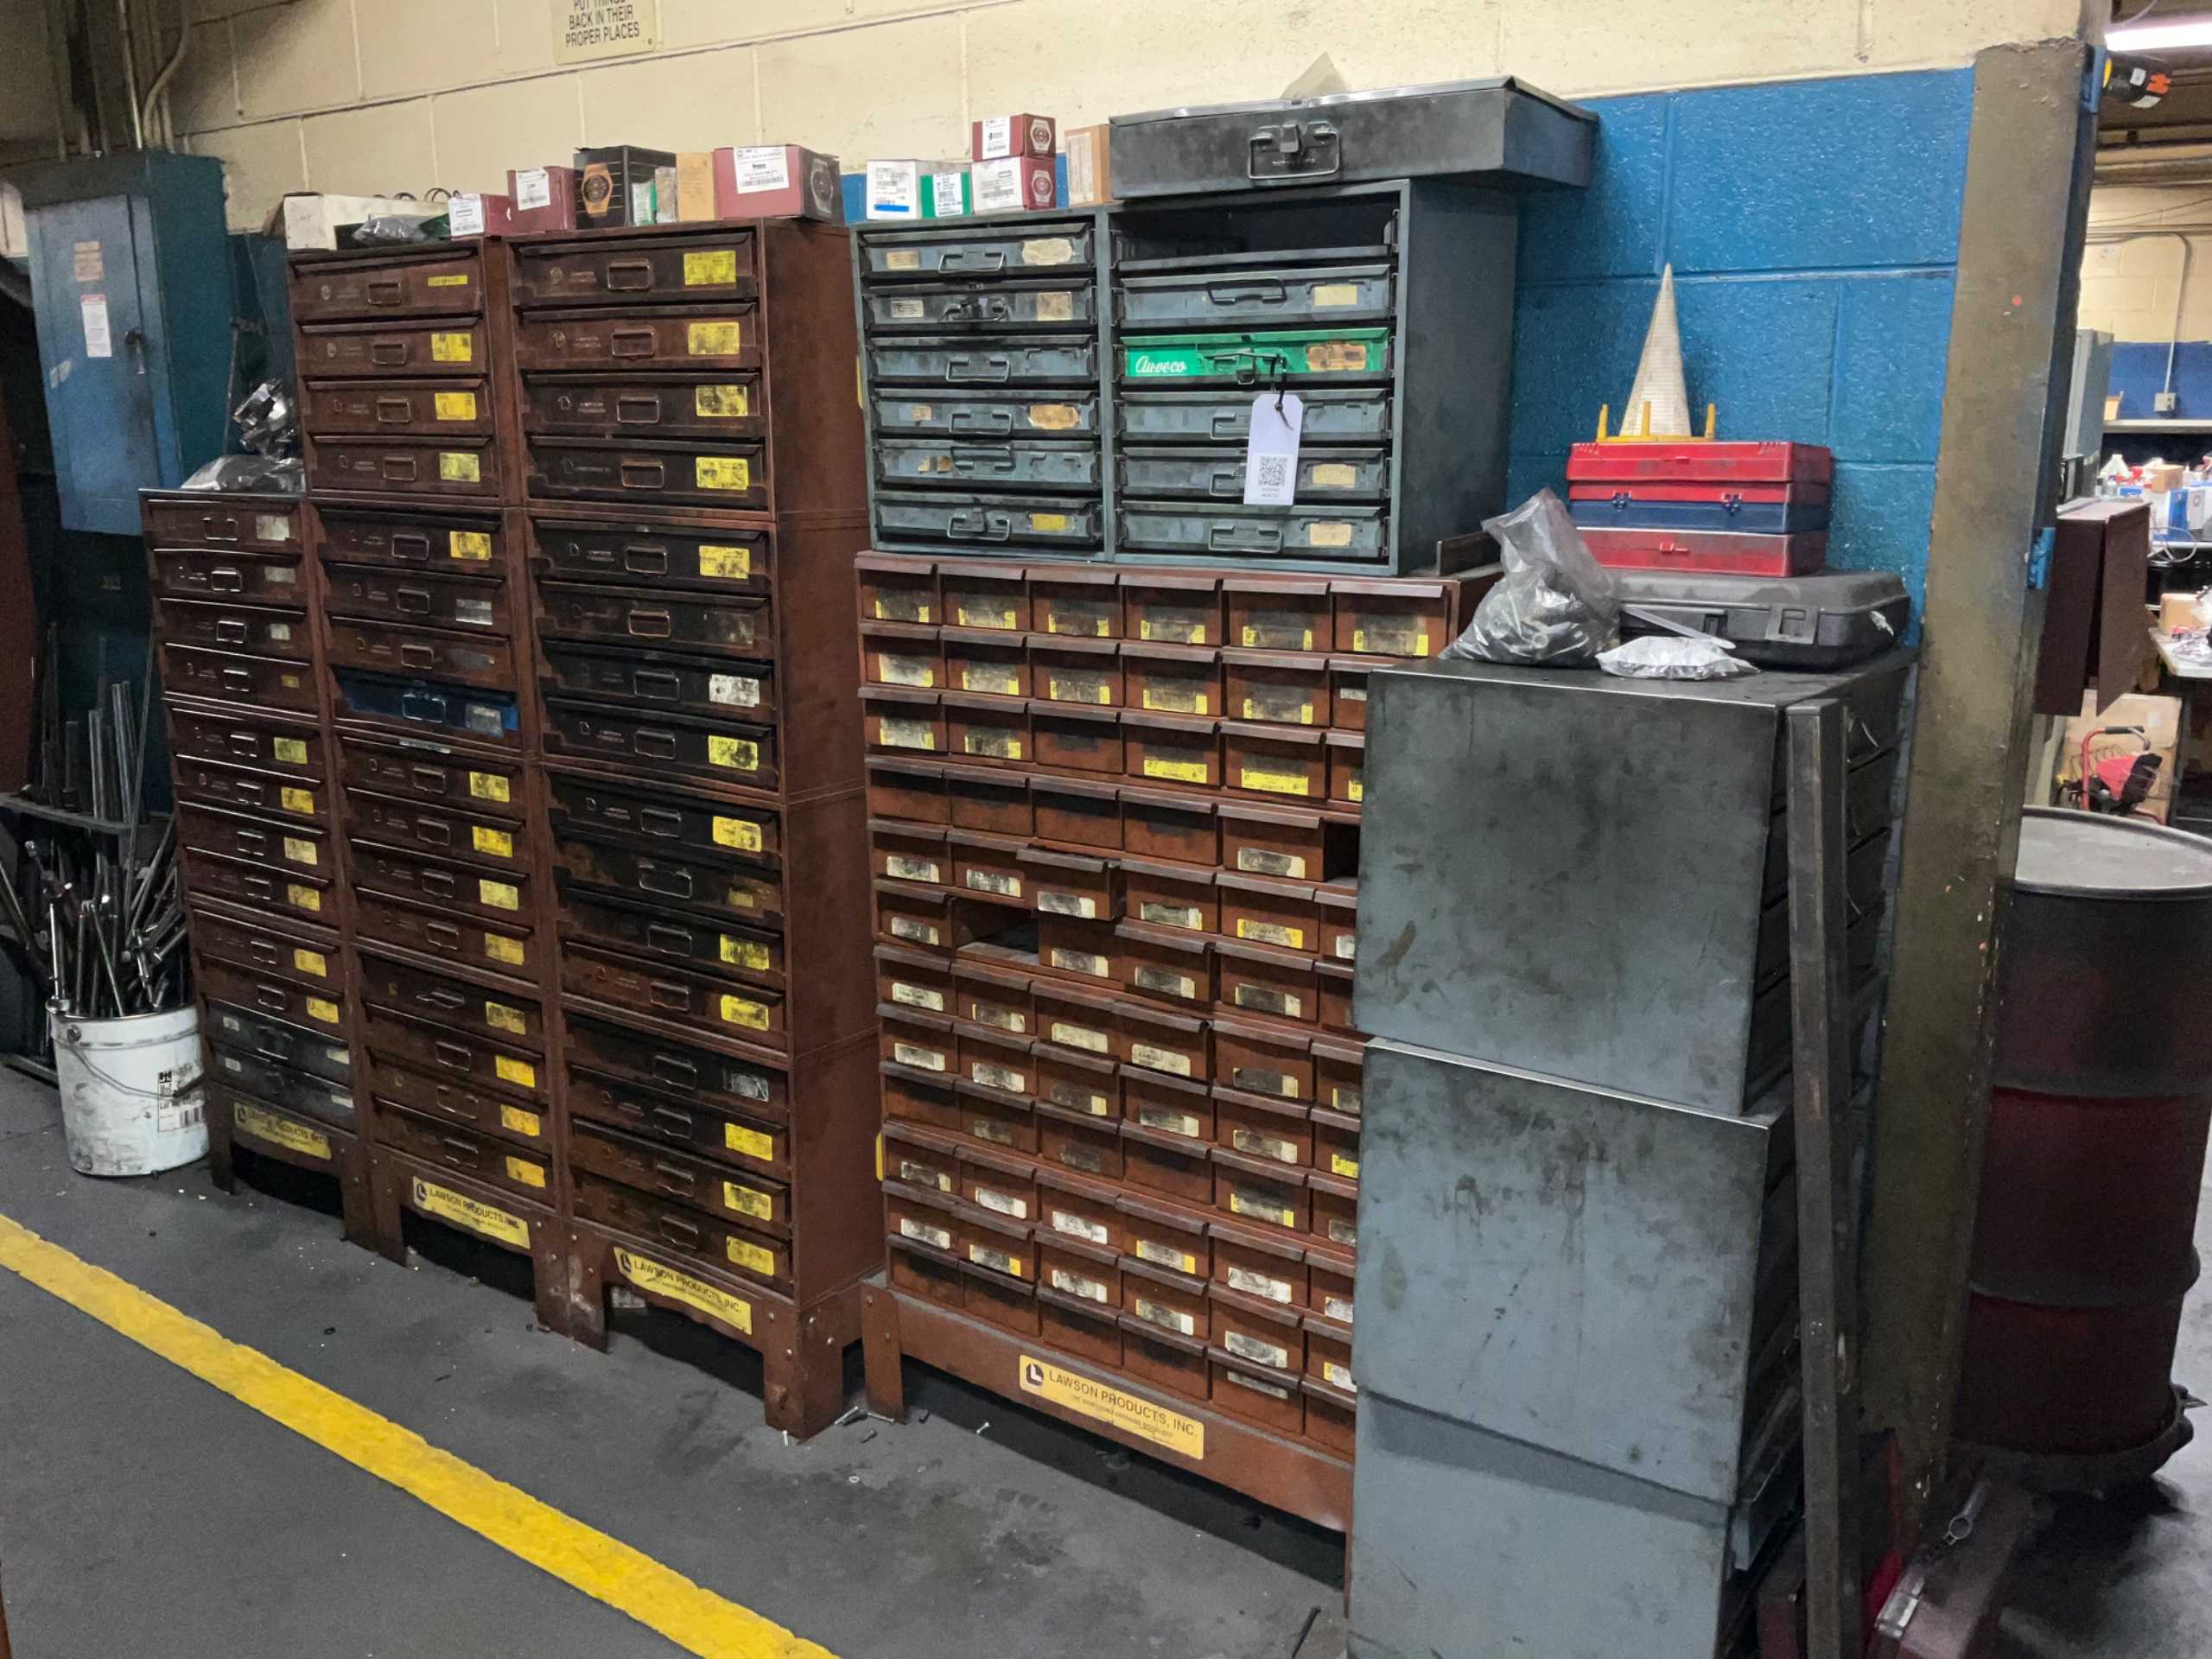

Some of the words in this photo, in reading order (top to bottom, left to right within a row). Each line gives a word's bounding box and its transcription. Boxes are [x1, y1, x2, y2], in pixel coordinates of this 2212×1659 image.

[569, 11, 594, 29] BACK
[594, 10, 605, 25] IN
[607, 4, 634, 23] THEIR
[565, 28, 601, 48] PROPER
[603, 22, 640, 41] PLACES
[1049, 1370, 1099, 1397] LAWSON
[1101, 1389, 1170, 1428] PRODUCTS,
[1173, 1419, 1198, 1438] INC.
